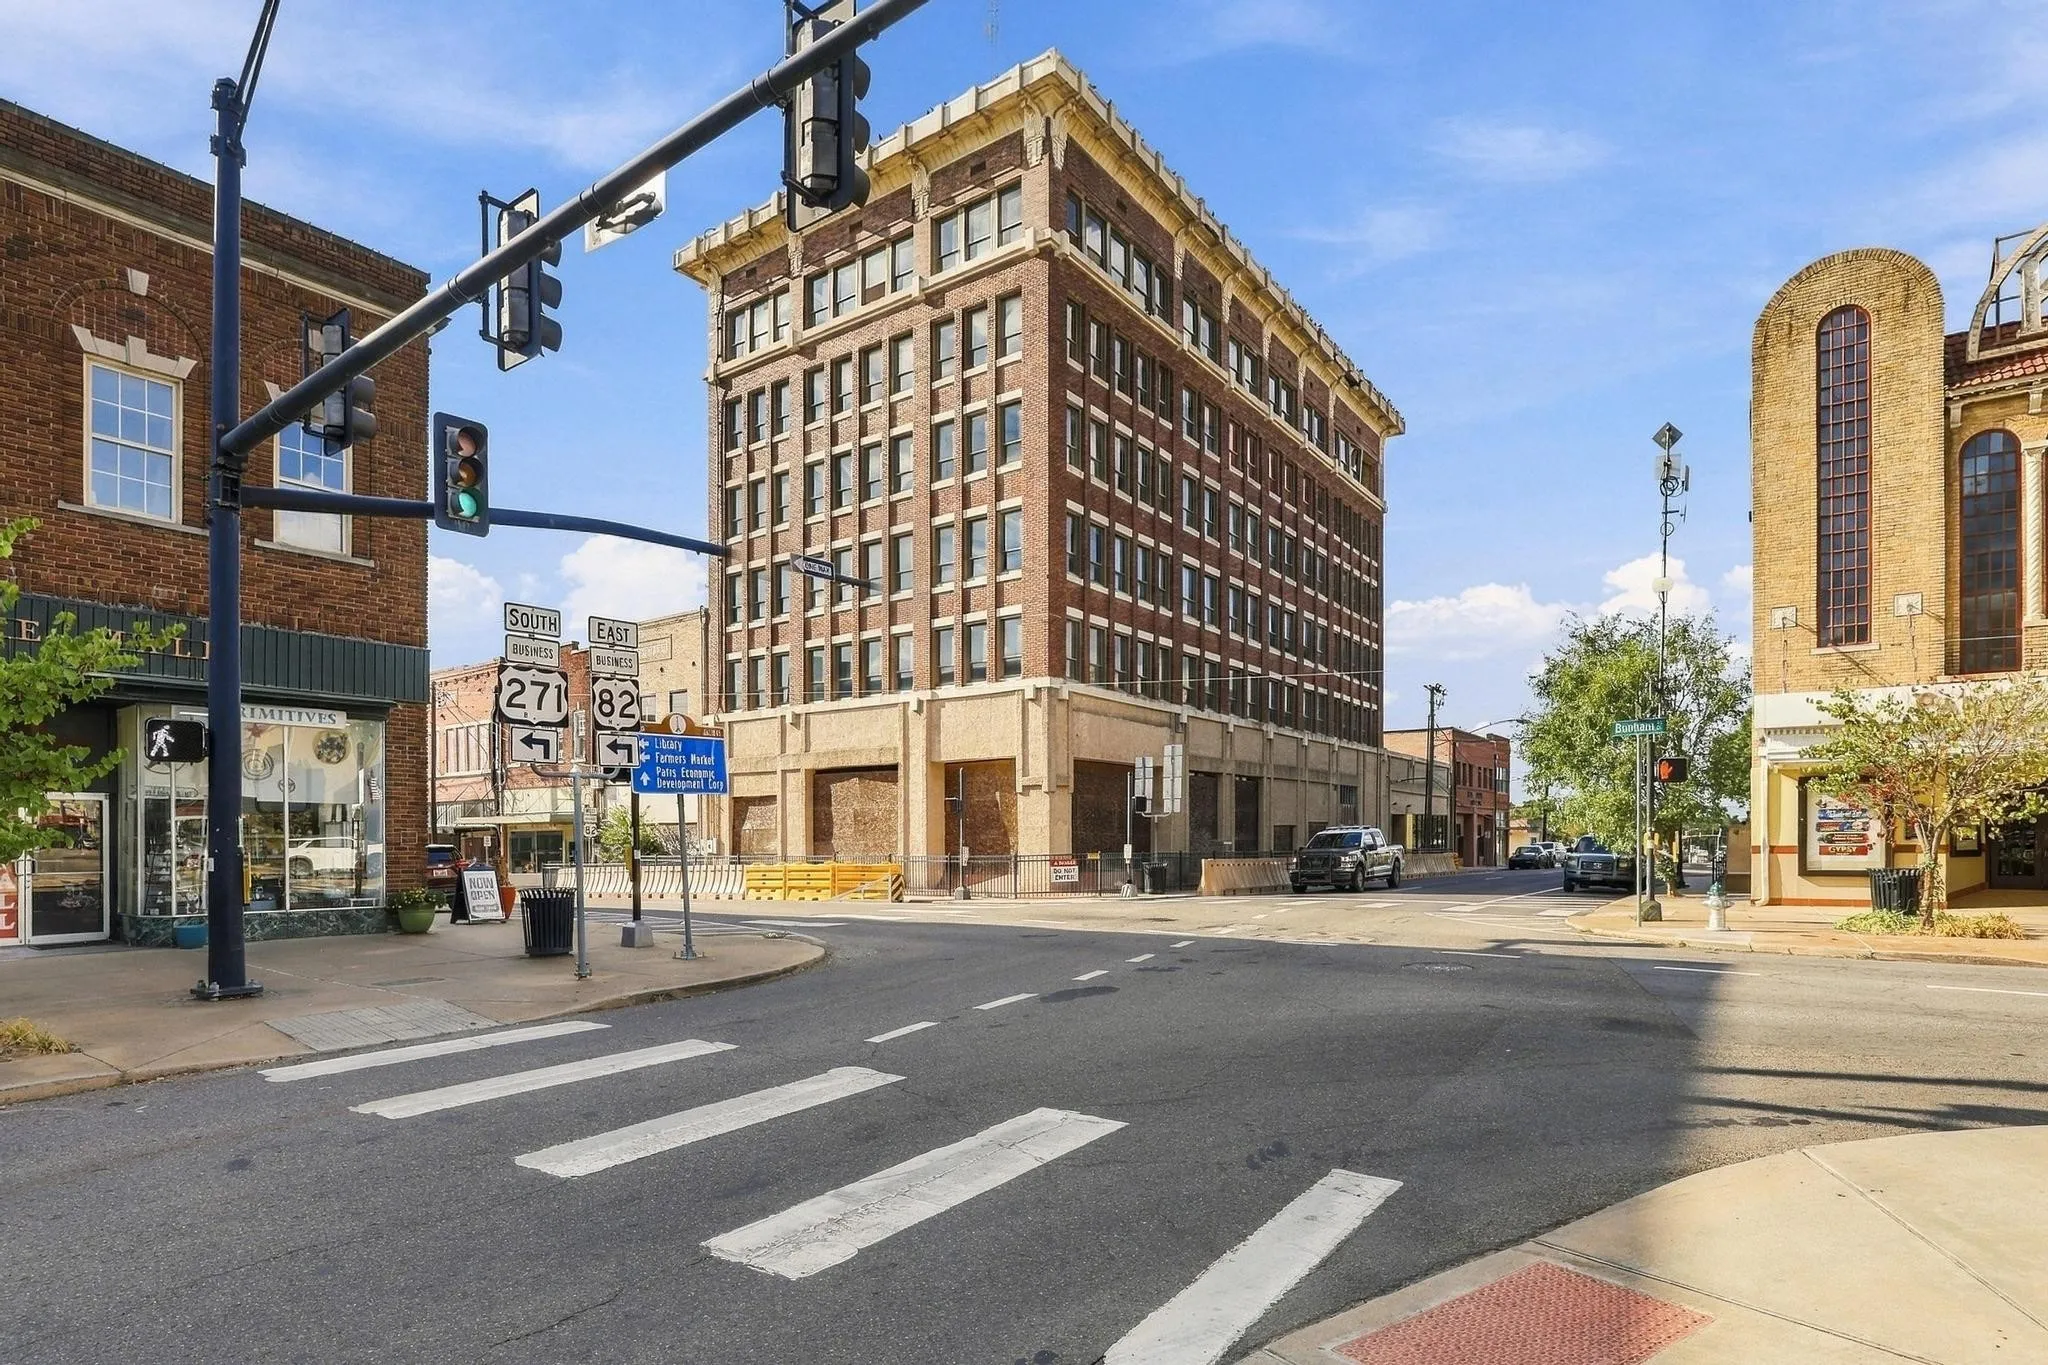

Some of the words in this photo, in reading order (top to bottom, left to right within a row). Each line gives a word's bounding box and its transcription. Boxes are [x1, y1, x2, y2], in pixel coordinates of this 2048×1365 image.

[509, 608, 557, 632] SOUTH
[597, 622, 630, 642] EAST
[512, 643, 554, 660] BUSINESS
[596, 655, 633, 669] BUSINESS
[506, 678, 562, 713] 271
[598, 688, 636, 719] 82
[1615, 722, 1655, 733] Bonham
[655, 738, 682, 752] Library
[655, 752, 686, 764] Farmers
[691, 753, 715, 765] Market
[656, 767, 676, 778] Paris
[681, 767, 715, 779] Economic
[657, 777, 704, 790] Development
[708, 779, 724, 791] Corp
[469, 877, 494, 889] NOW
[471, 890, 496, 901] OPEN
